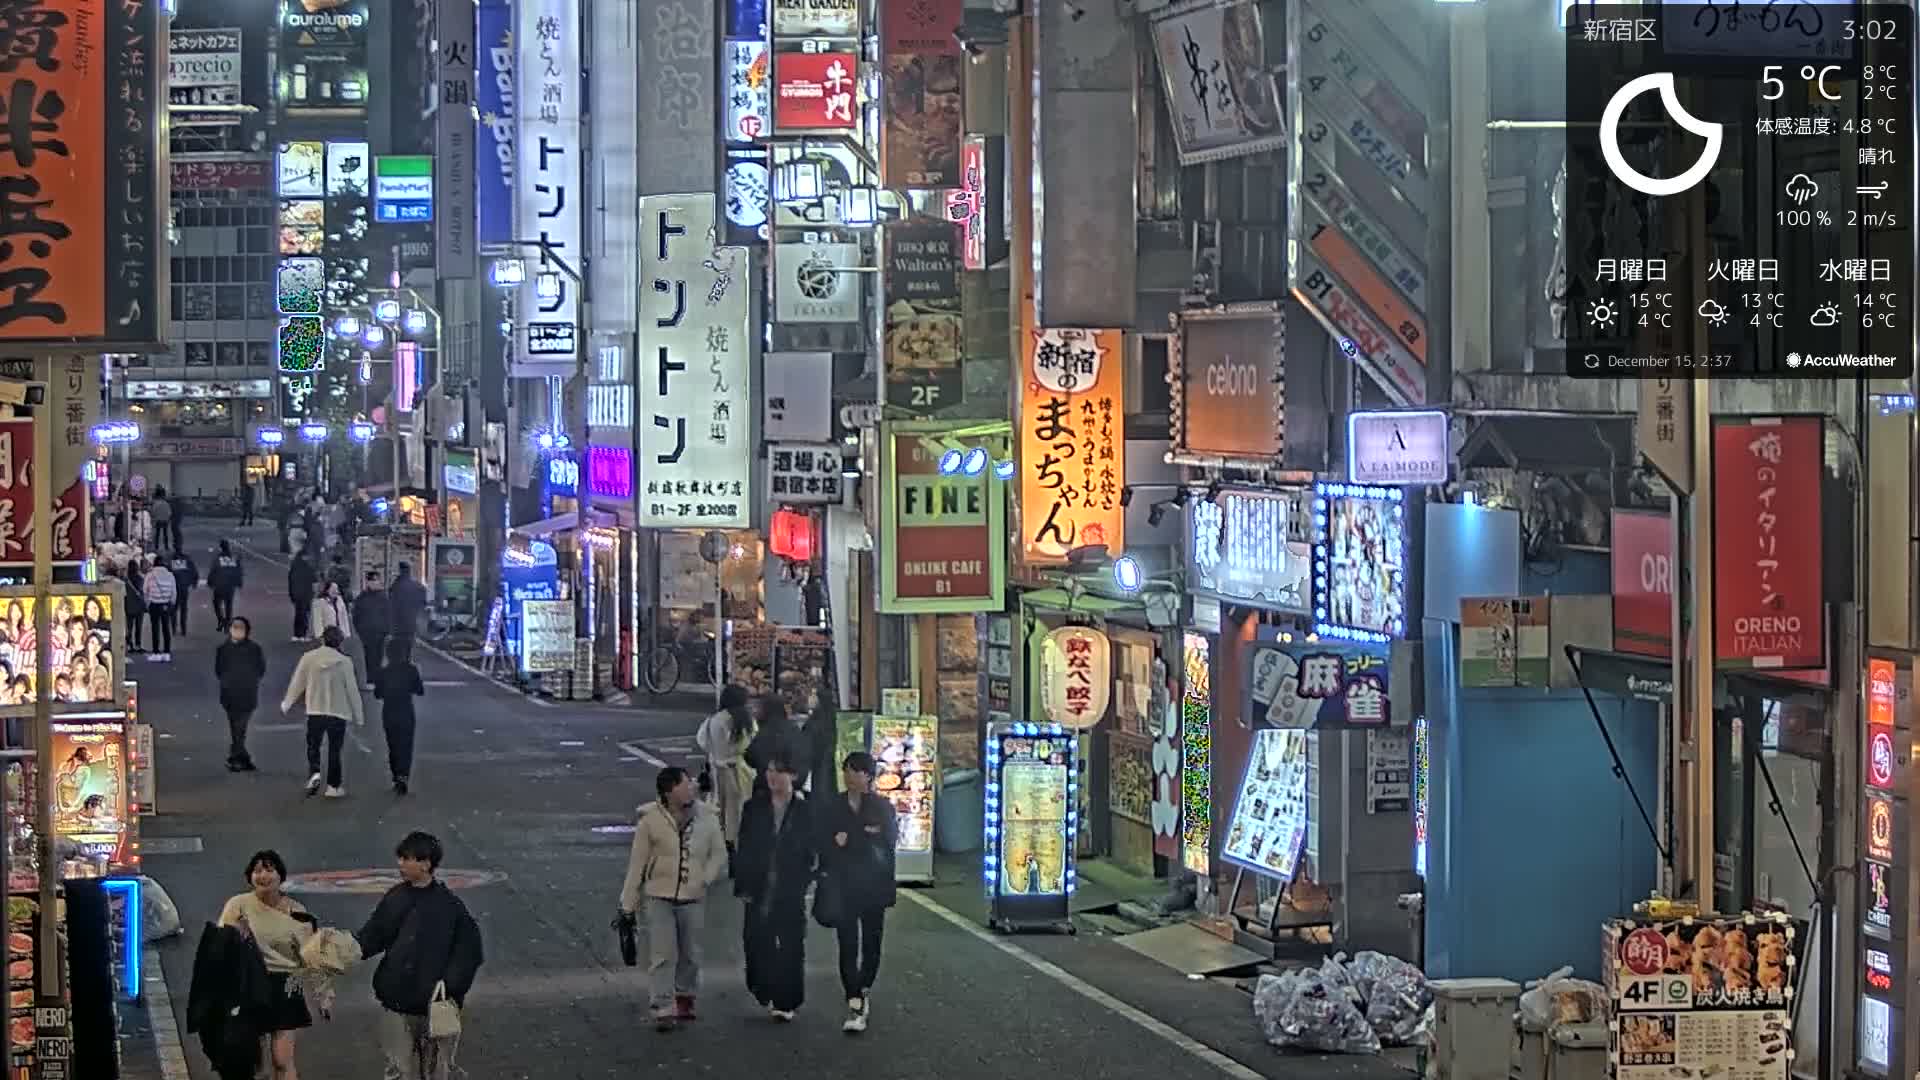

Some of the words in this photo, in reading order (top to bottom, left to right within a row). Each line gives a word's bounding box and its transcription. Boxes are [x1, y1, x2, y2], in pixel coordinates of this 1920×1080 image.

[823, 59, 853, 121] 牛門
[1305, 270, 1333, 298] B1
[653, 210, 687, 463] トントン
[1037, 343, 1097, 376] 新宿
[1058, 373, 1078, 390] の
[1206, 355, 1258, 396] celona
[911, 385, 941, 405] 2F
[773, 451, 838, 473] 酒場心
[1035, 396, 1080, 545] まっちゃん
[772, 475, 838, 494] 新宿本店
[904, 485, 981, 515] FINE
[1749, 431, 1784, 605] 俺のイタリアン
[904, 560, 949, 576] ONLINE
[951, 560, 983, 575] CAFE
[1640, 553, 1672, 593] OR
[935, 579, 952, 593] B1
[1734, 616, 1801, 634] ORENO
[1733, 634, 1802, 653] ITALIAN
[1300, 654, 1388, 723] 麻雀
[1623, 981, 1660, 1003] 4F
[1696, 987, 1784, 1006] 炭火焼き鳥
[36, 1008, 67, 1027] NERO
[39, 1040, 68, 1057] NERO
